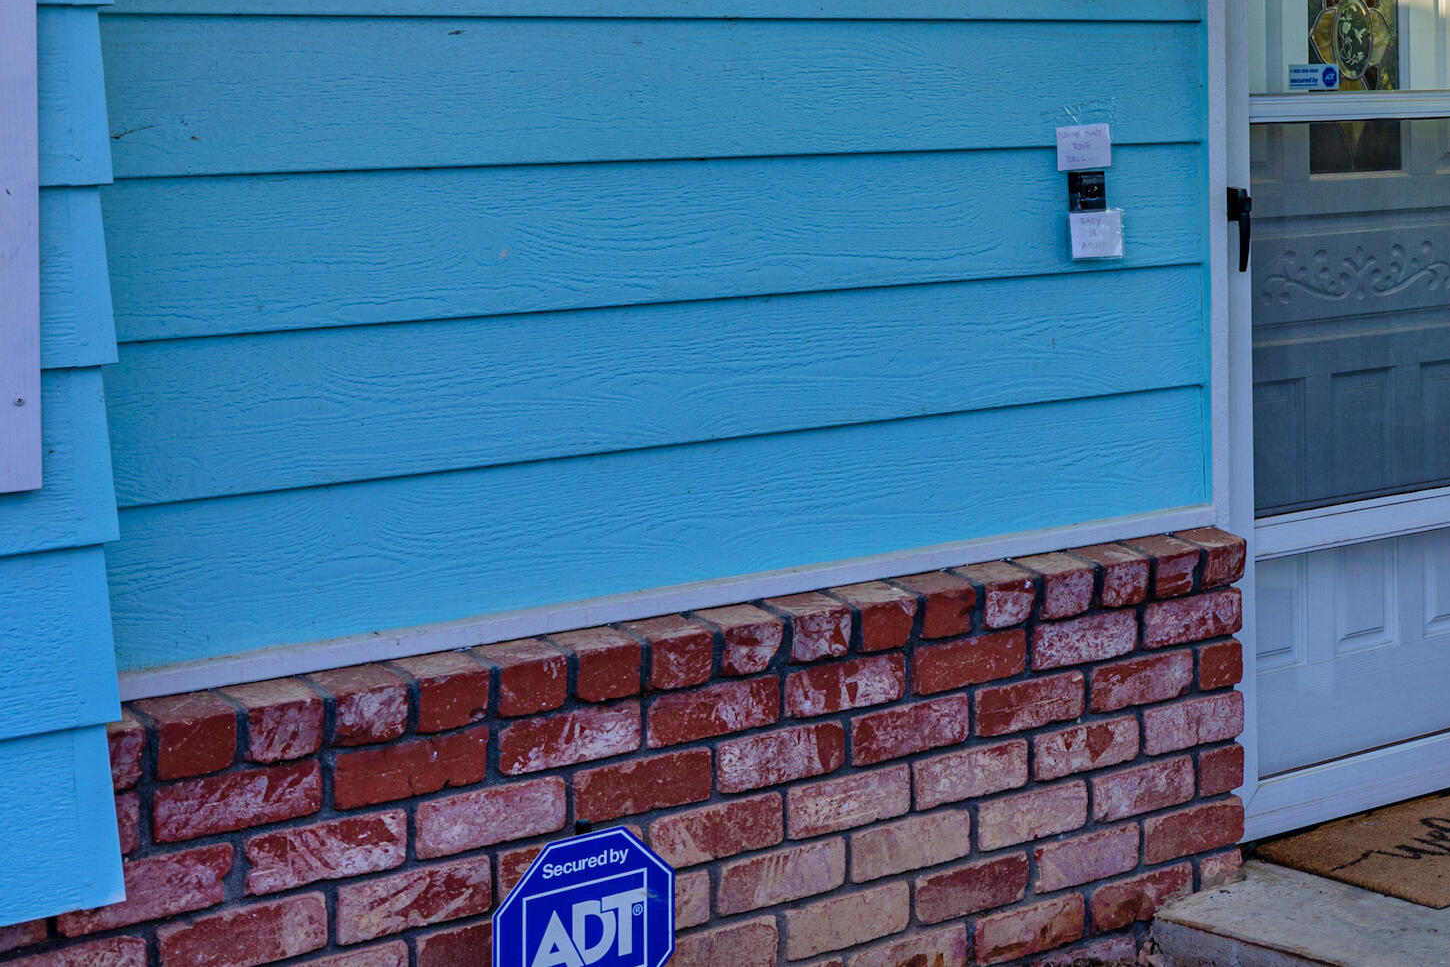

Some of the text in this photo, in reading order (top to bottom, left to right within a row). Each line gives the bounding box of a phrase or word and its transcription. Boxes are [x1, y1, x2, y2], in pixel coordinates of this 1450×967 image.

[541, 848, 629, 880] Secured by
[531, 887, 647, 967] ADT
